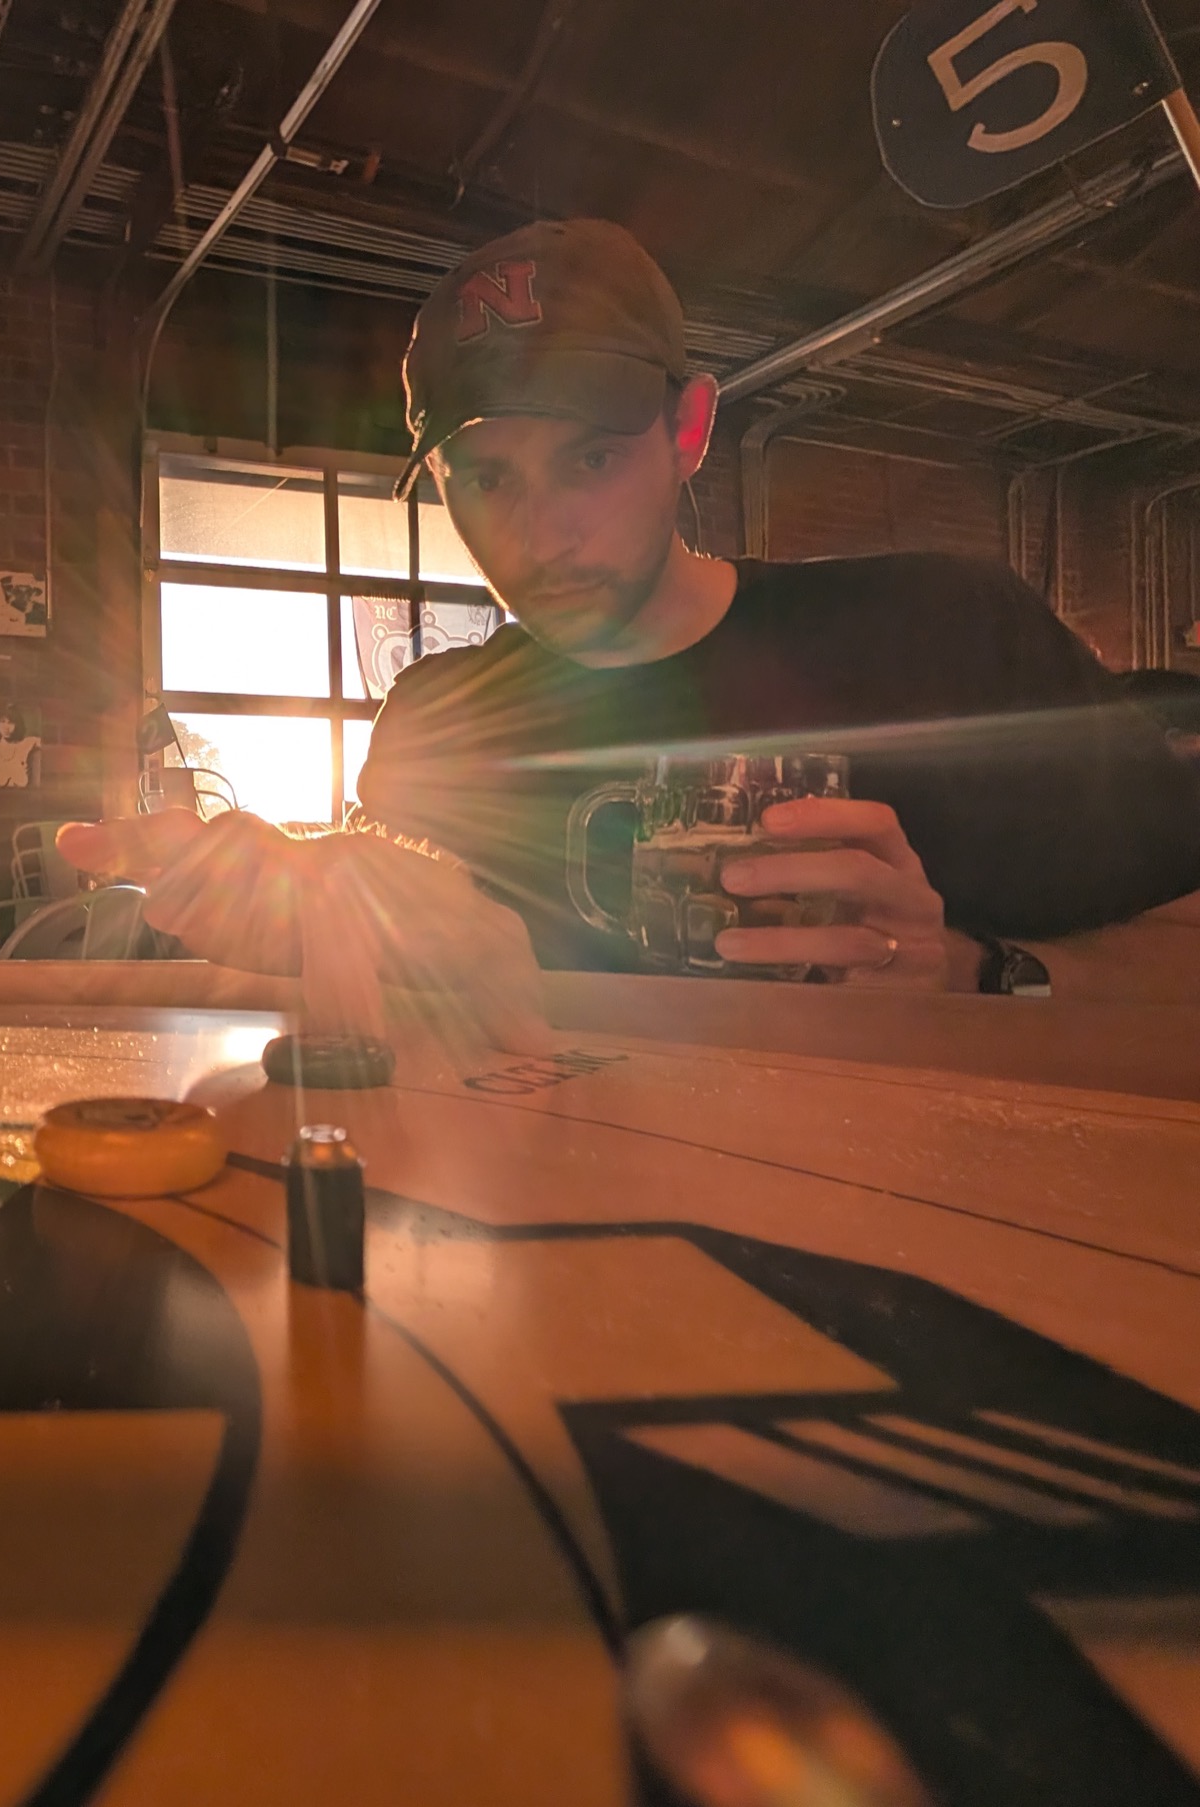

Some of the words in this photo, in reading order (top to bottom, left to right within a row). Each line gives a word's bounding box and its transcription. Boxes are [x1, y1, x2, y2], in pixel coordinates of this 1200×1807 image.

[927, 0, 1088, 153] 5
[457, 260, 543, 343] N
[374, 605, 397, 621] NC
